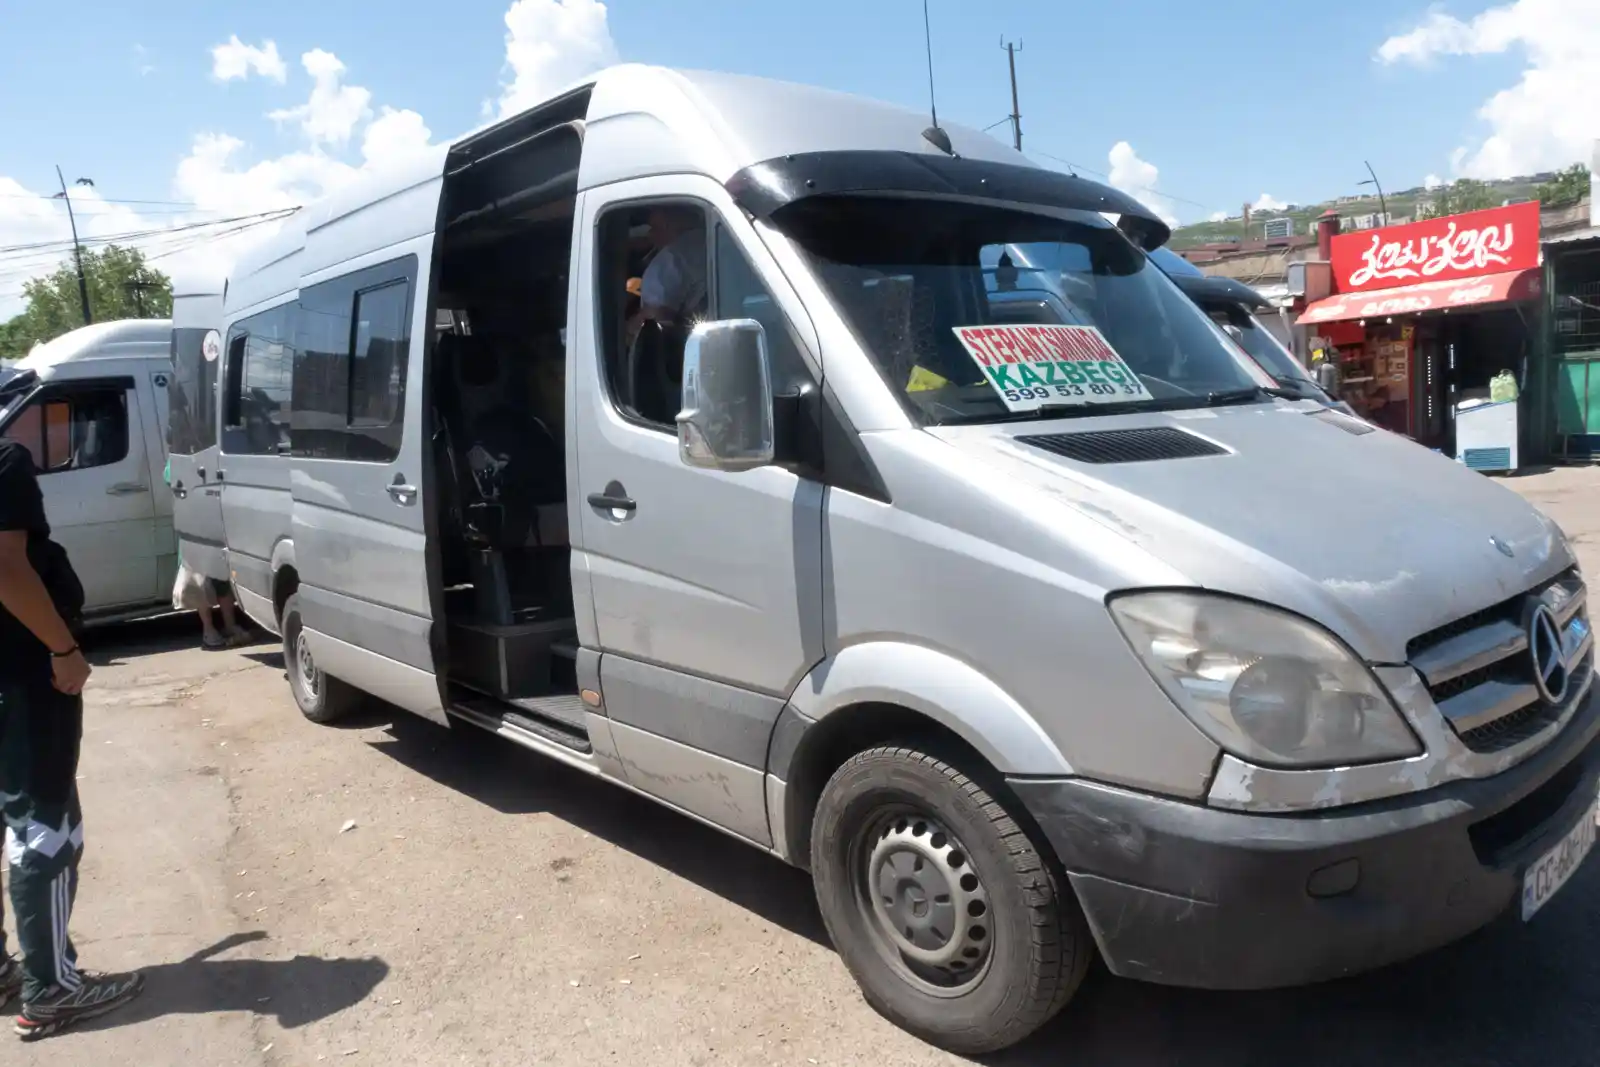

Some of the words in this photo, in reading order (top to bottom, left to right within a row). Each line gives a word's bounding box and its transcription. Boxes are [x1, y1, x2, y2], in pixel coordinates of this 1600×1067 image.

[961, 327, 1121, 366] STEPANTSMINDA
[986, 361, 1136, 390] KAZBEGI
[1005, 388, 1050, 402] 599
[1056, 384, 1085, 397] 53
[1089, 384, 1115, 395] 80
[1123, 383, 1143, 395] 37
